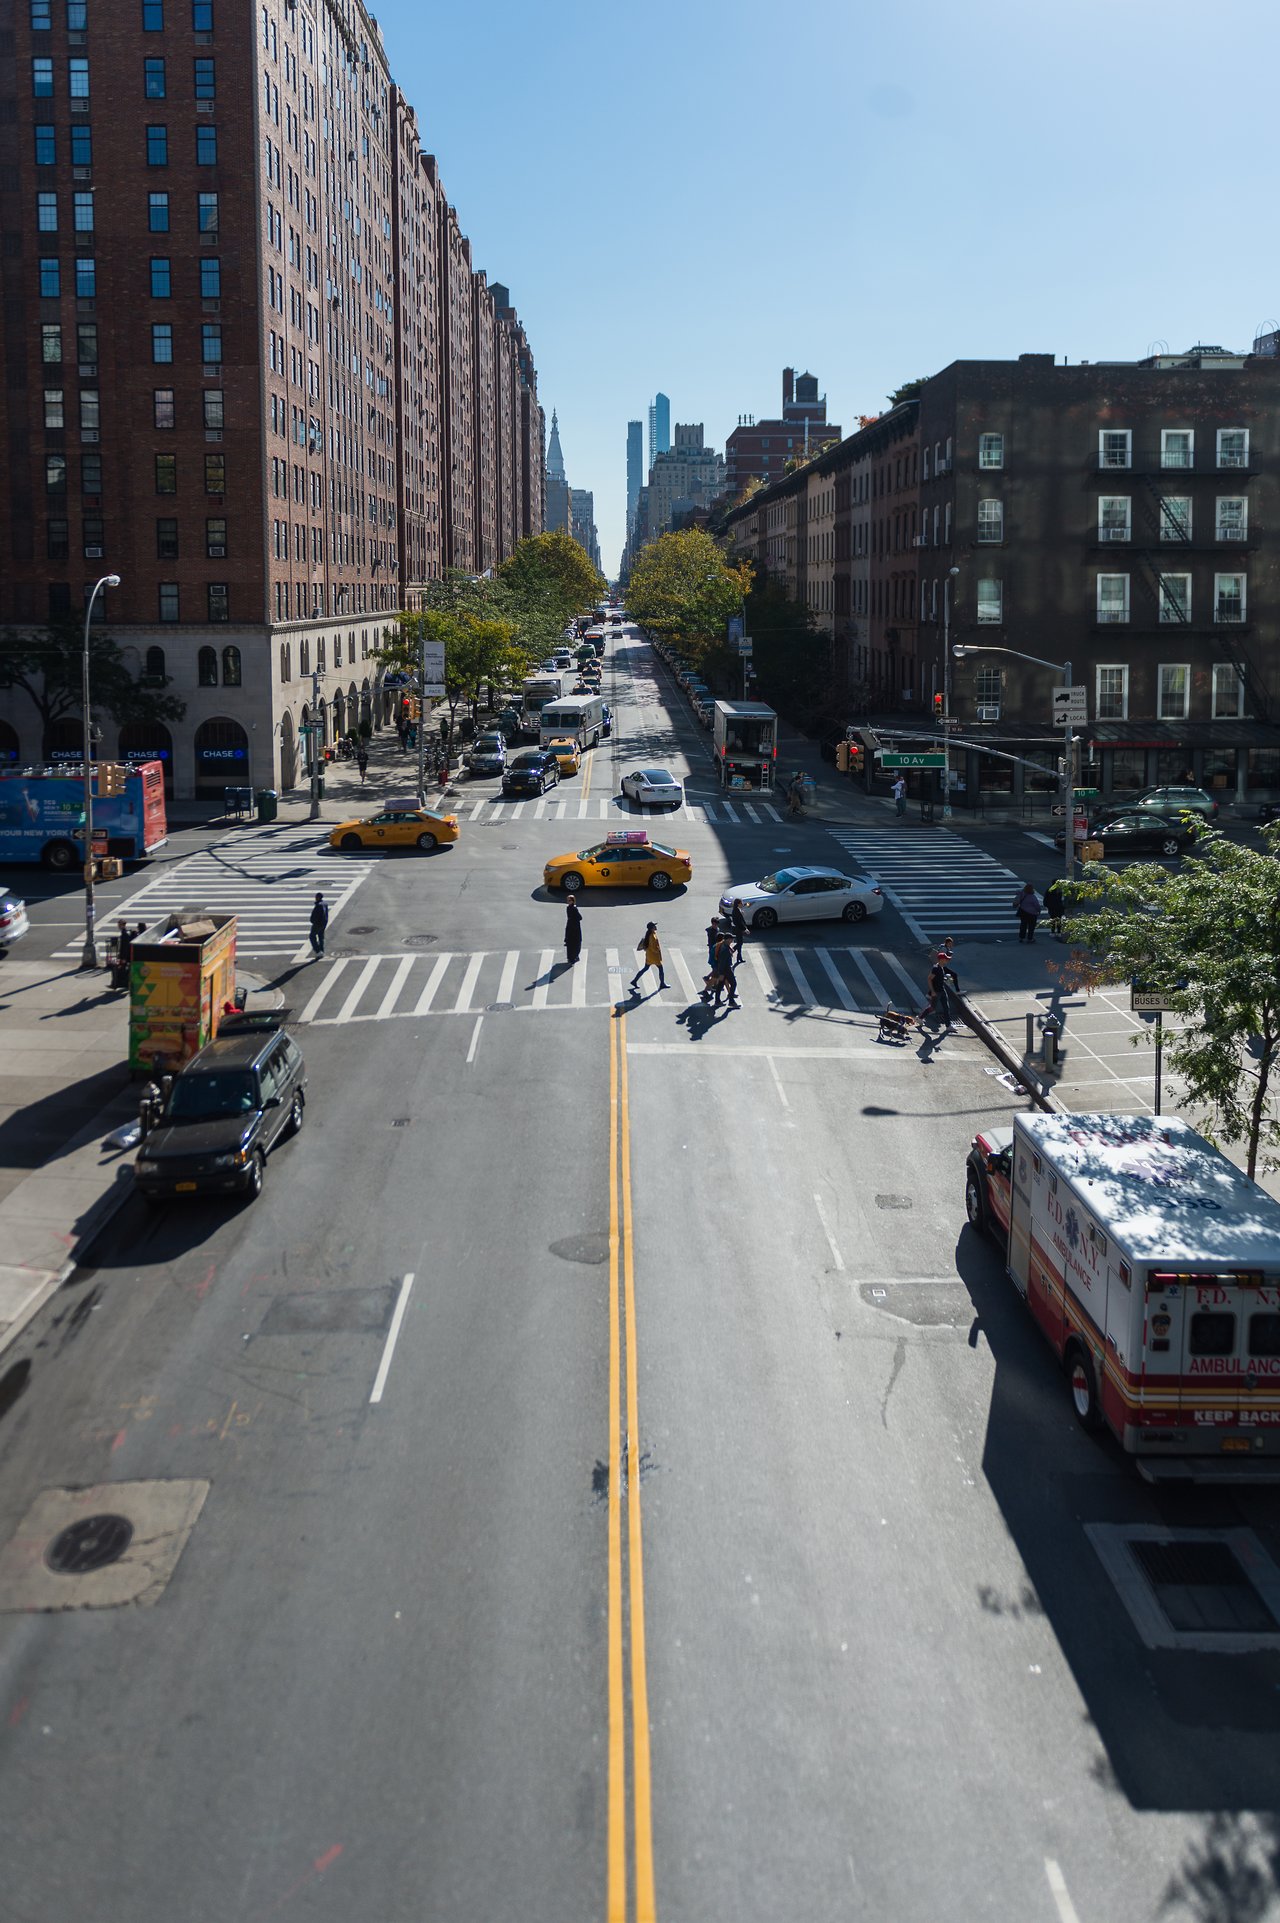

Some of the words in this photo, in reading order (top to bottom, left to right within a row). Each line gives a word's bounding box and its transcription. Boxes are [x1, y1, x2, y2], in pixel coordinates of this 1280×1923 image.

[51, 751, 82, 759] CHASE
[203, 750, 234, 758] CHASE
[62, 803, 71, 811] 10
[1134, 997, 1161, 1005] BUSES
[1153, 1196, 1222, 1210] 558
[1052, 1232, 1091, 1292] AMBULANCE
[1197, 1289, 1232, 1304] F.D.
[1194, 1410, 1234, 1422] KEEP
[1239, 1411, 1280, 1423] BACK
